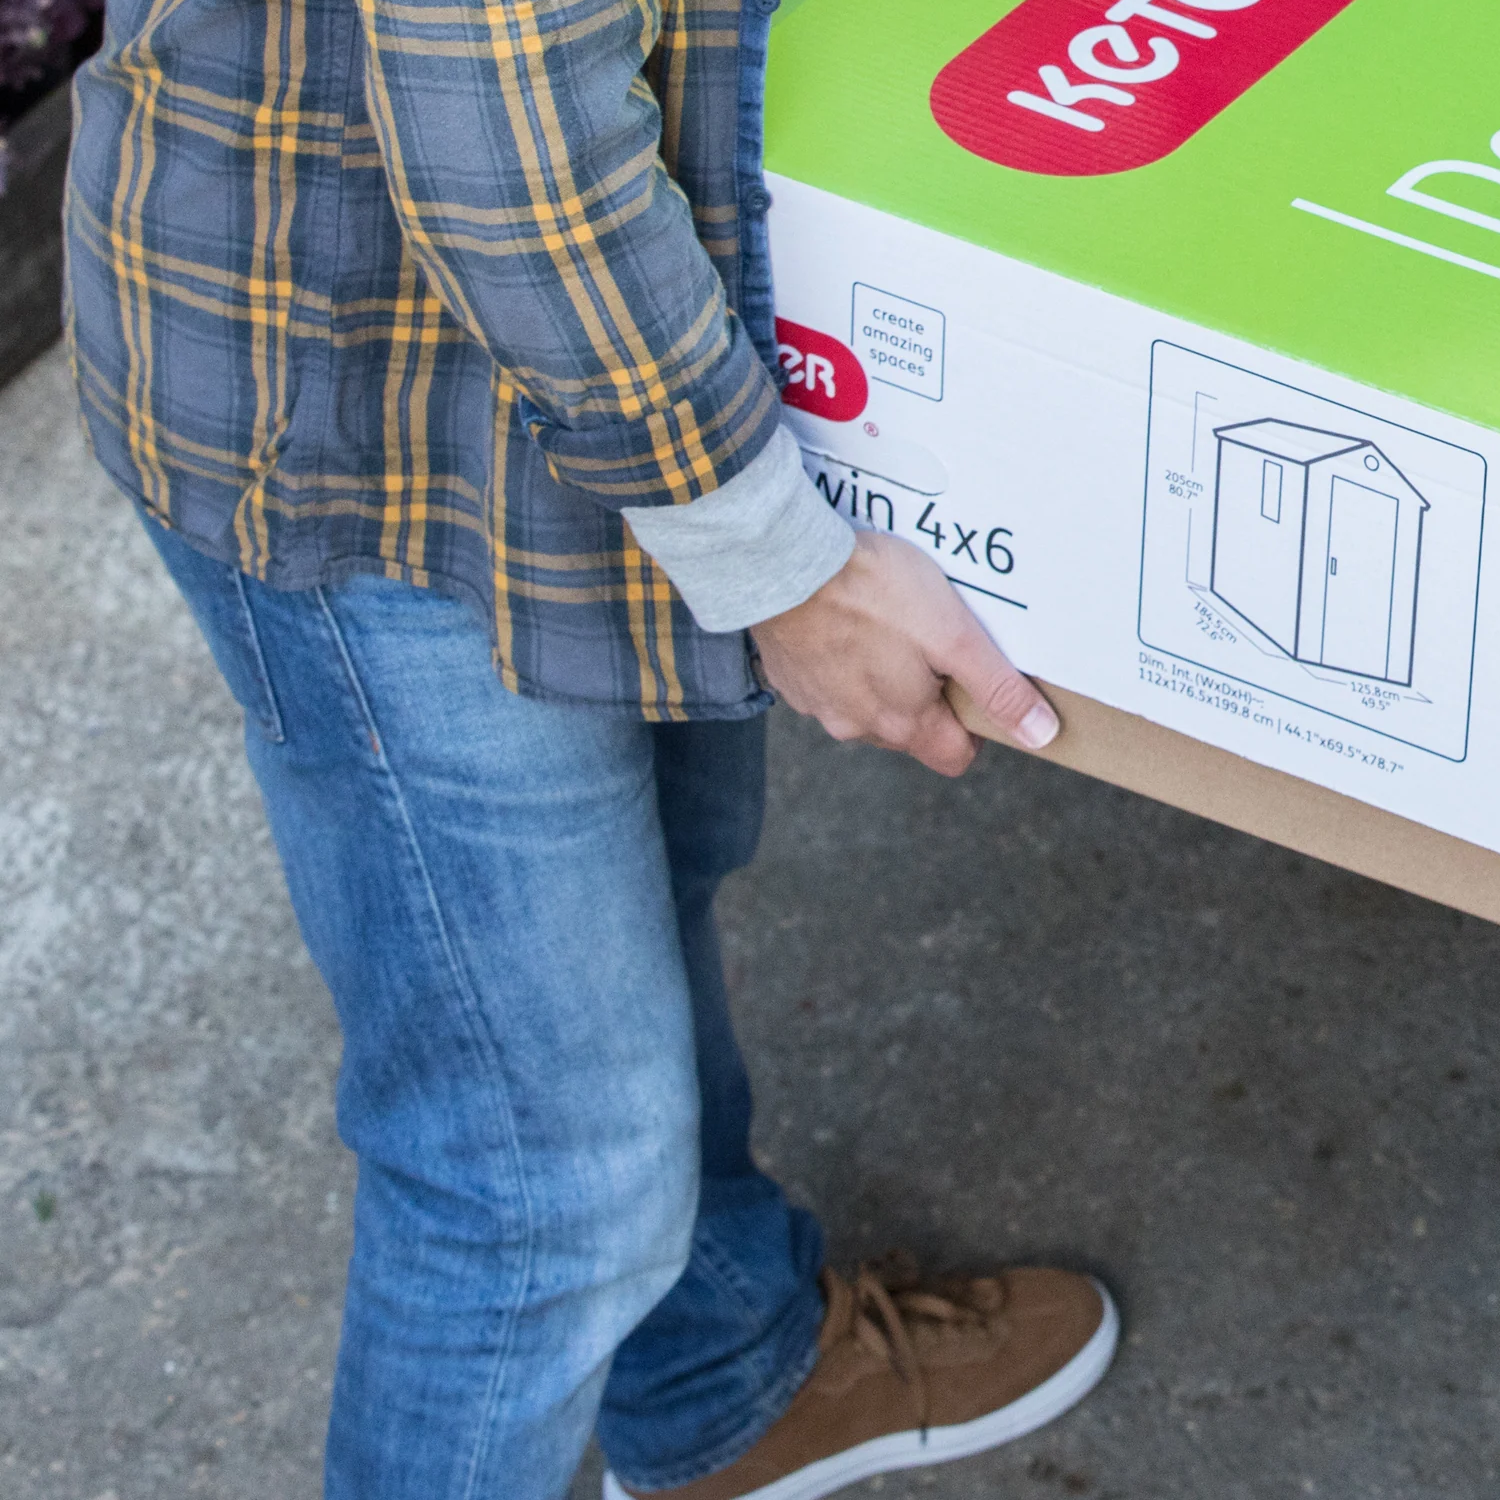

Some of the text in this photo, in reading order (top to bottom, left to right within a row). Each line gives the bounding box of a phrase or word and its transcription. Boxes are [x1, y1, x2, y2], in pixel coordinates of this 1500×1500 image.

[872, 306, 925, 336] create
[862, 323, 934, 362] amazing
[869, 346, 926, 377] spaces
[1165, 469, 1204, 492] 205cm
[915, 501, 1015, 575] 4x6
[1138, 651, 1168, 673] Dim.
[1138, 667, 1251, 719] 112x176.5x199.8
[1253, 712, 1274, 728] cm
